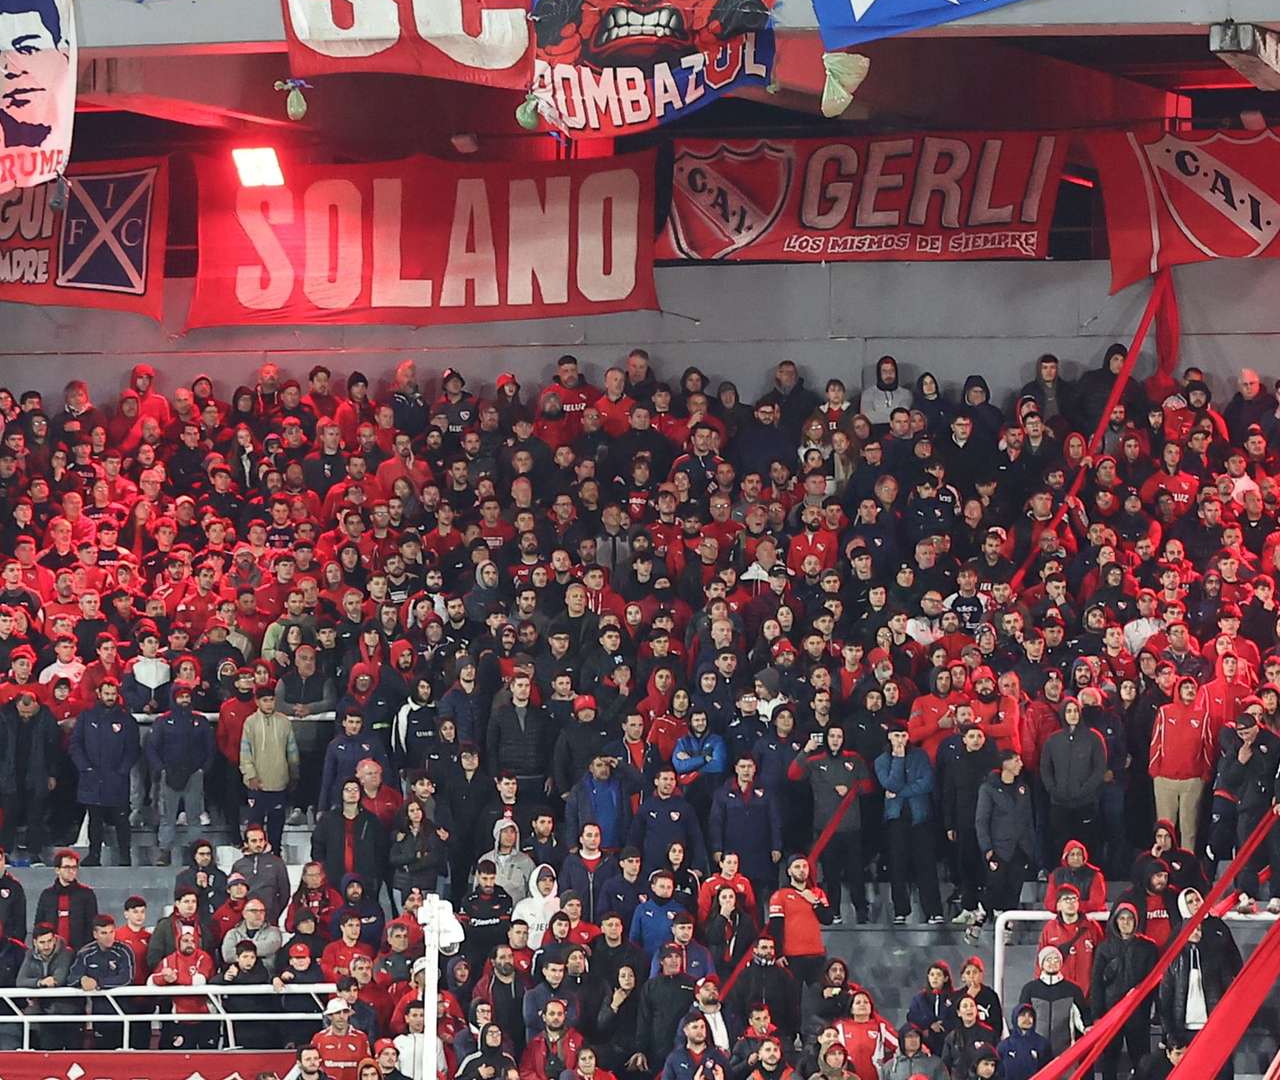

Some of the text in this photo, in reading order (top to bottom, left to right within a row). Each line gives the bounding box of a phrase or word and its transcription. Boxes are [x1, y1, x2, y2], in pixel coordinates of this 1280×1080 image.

[800, 134, 1058, 230] GERLI
[232, 167, 640, 311] SOLANO
[783, 230, 1039, 255] LOS MISMOS DE SIEMPRE
